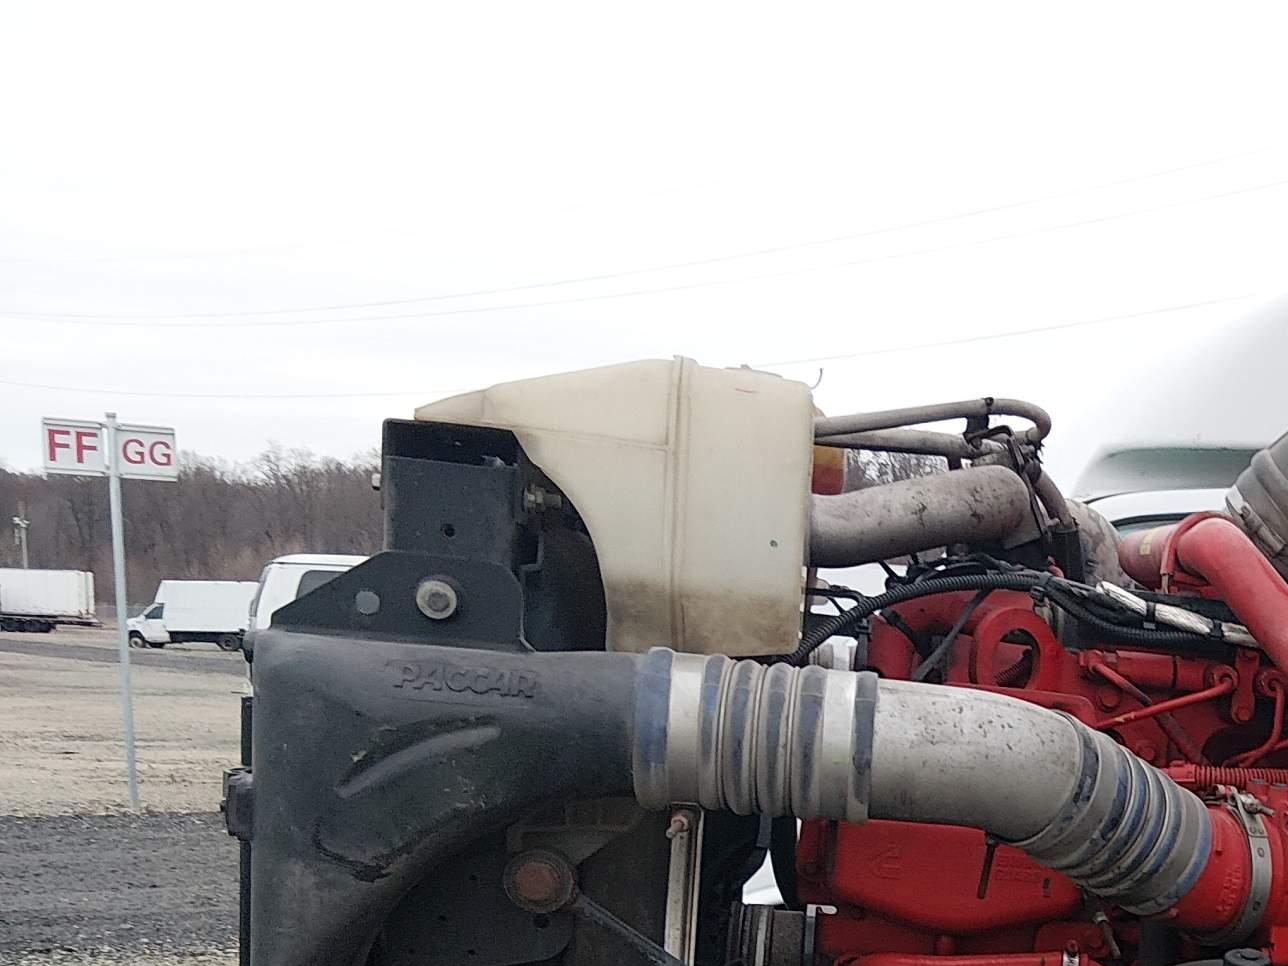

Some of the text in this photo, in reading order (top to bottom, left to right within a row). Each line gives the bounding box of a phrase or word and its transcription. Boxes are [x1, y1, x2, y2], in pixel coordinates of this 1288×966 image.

[47, 428, 98, 464] FF
[122, 438, 172, 466] GG
[391, 662, 538, 699] PACCAR
